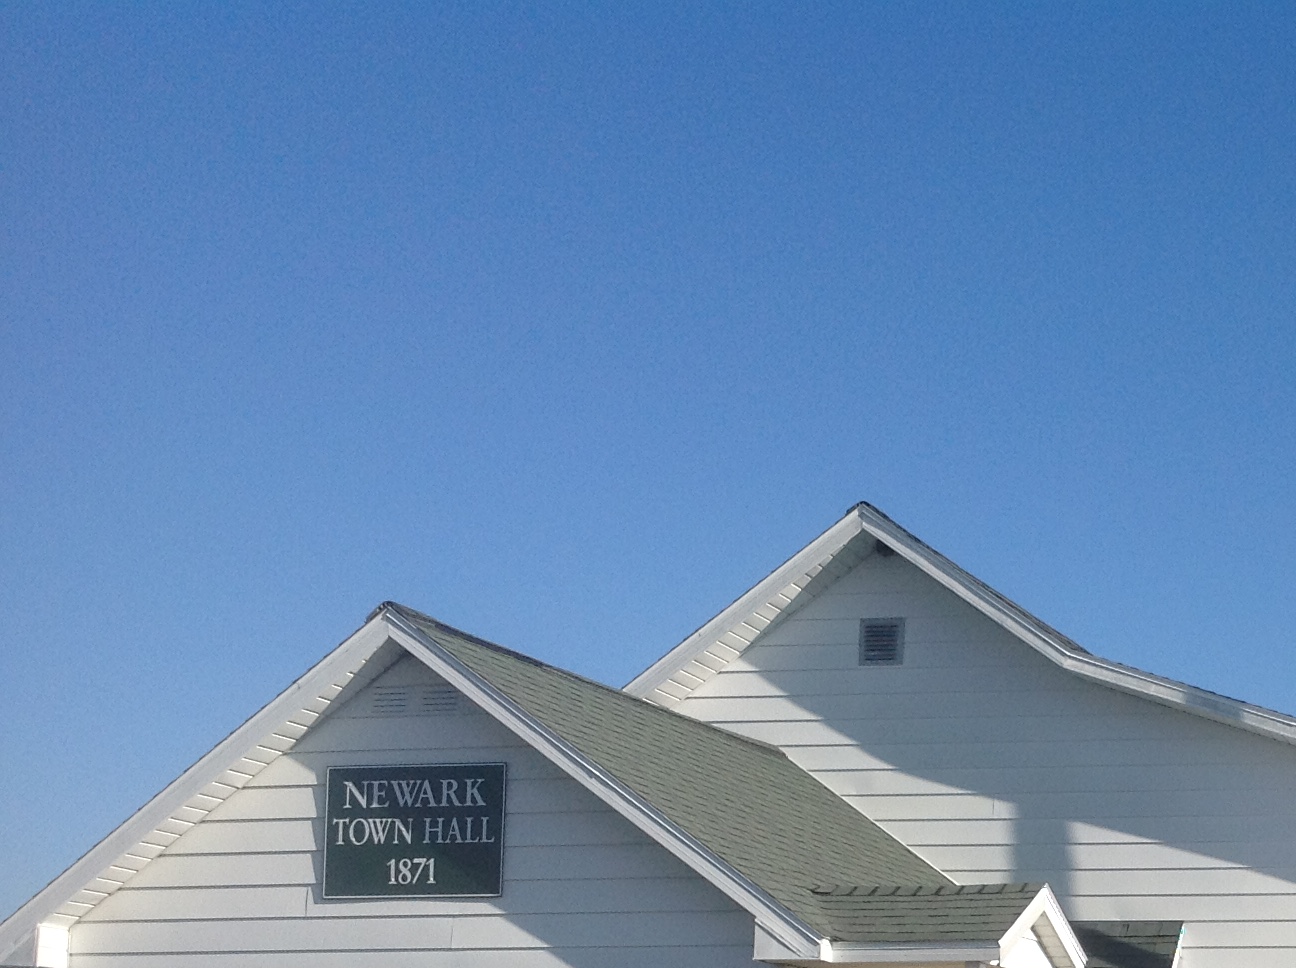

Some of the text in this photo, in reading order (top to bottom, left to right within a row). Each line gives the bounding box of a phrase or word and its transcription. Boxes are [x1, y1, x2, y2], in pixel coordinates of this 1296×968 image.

[343, 778, 486, 809] NEWARK
[333, 816, 496, 845] TOWN HALL
[387, 857, 437, 885] 1871
